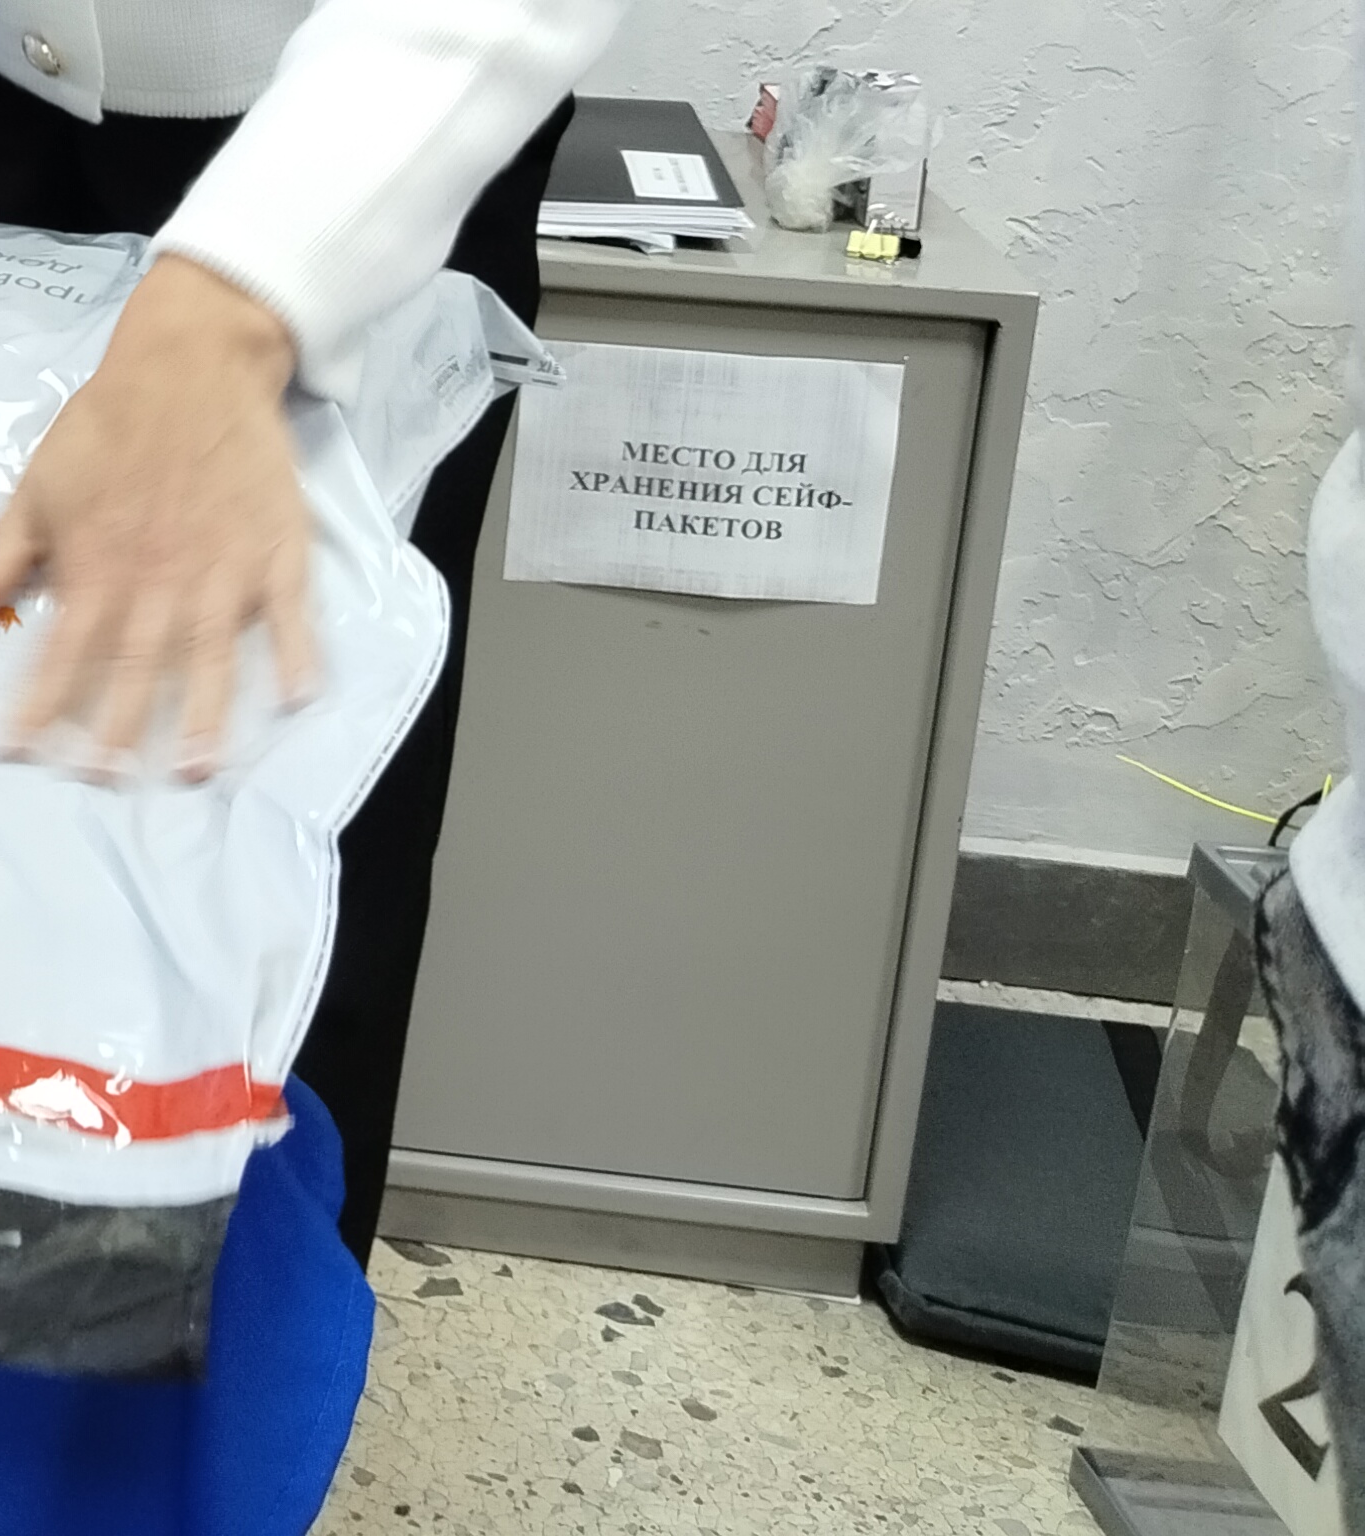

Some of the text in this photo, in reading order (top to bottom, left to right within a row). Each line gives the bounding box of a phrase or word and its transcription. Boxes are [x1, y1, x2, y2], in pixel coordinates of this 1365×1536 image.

[621, 440, 807, 475] МЕСТО ДЛЯ
[569, 470, 854, 510] ХРАНЕНИЯ СЕЙФ-
[633, 509, 783, 541] ПАКЕТОВ
